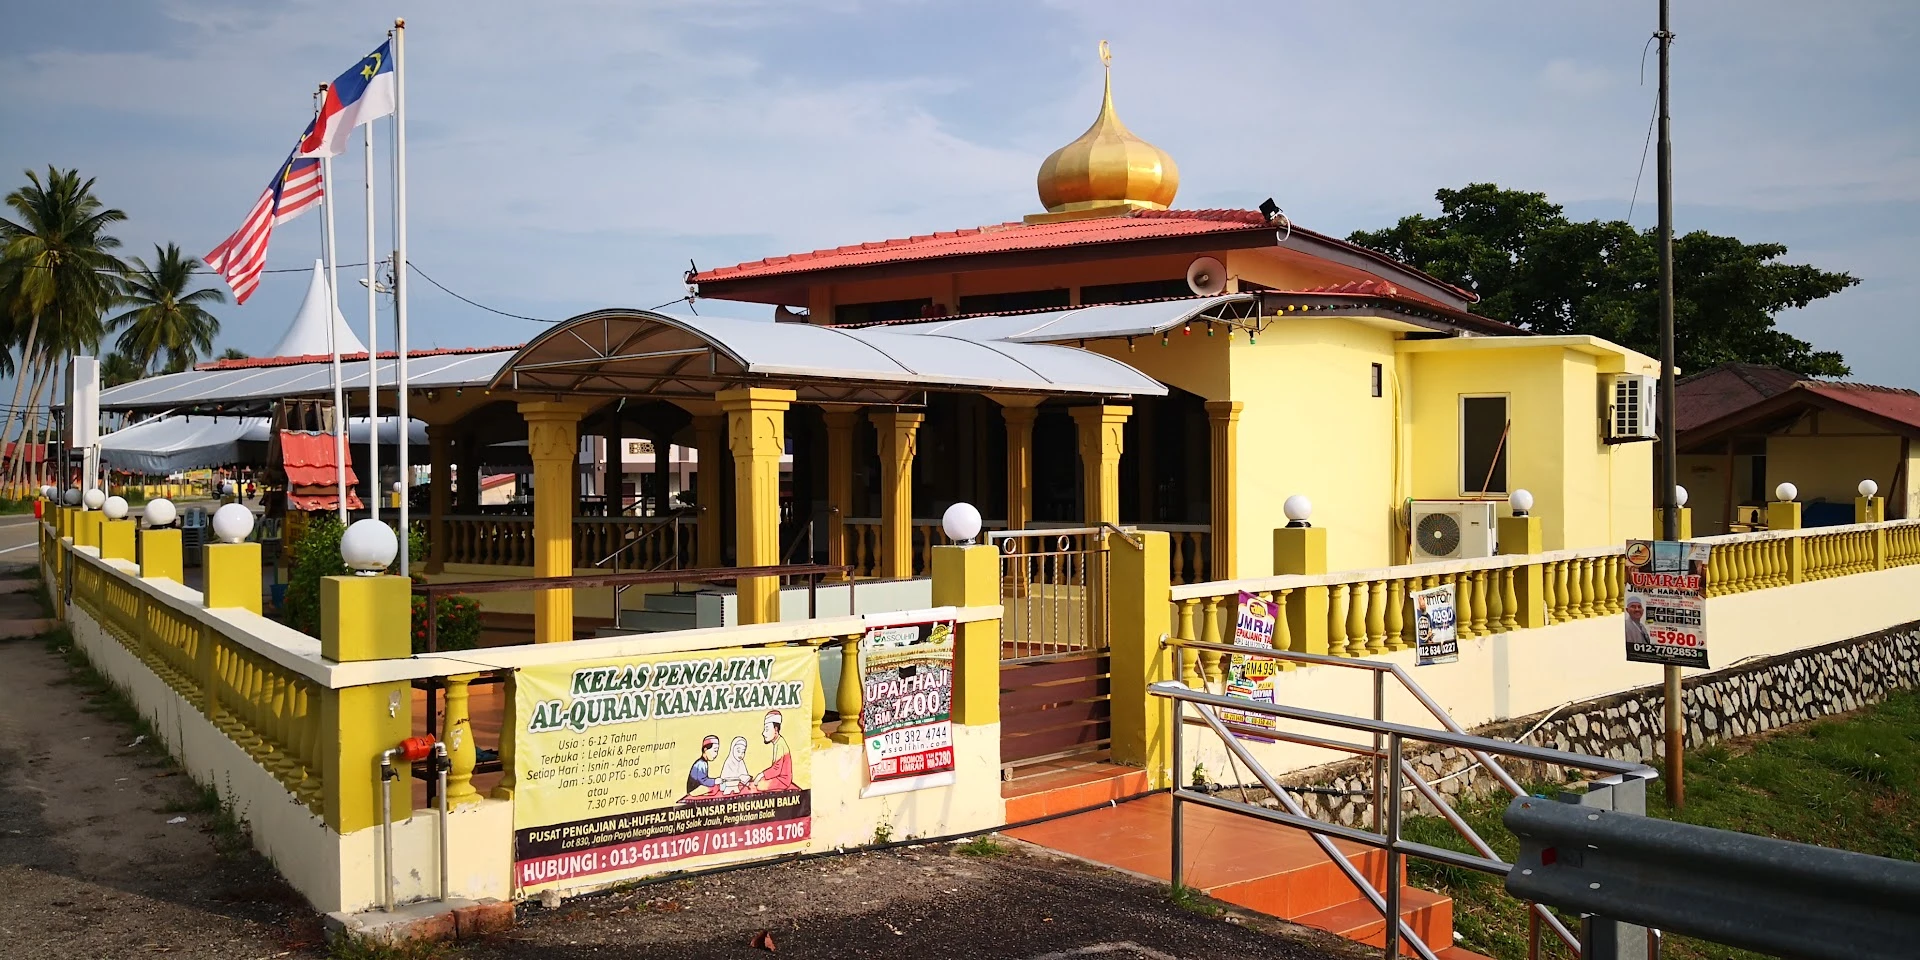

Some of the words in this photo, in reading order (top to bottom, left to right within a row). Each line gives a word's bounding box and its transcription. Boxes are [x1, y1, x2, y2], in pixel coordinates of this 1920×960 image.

[1632, 573, 1699, 589] UMRAH
[1657, 588, 1699, 597] HARAMAIN
[1430, 645, 1441, 656] 634
[1633, 643, 1698, 658] 012-7702853
[1657, 631, 1697, 647] 5980
[572, 666, 650, 695] KELAS
[651, 657, 774, 687] PENGAJIAN
[867, 676, 908, 701] UPAH
[912, 669, 948, 692] HAJI
[530, 693, 651, 731] AL-QURAN
[654, 683, 802, 717] KANAK-KANAK
[875, 709, 890, 726] RM
[892, 691, 941, 720] 1700
[558, 738, 579, 750] Usia
[588, 735, 608, 747] 6-12
[610, 732, 638, 745] Tahun
[904, 729, 921, 743] 382
[925, 726, 947, 741] 4744
[541, 752, 579, 765] Terbuka
[588, 746, 616, 760] Lelaki
[616, 745, 624, 755] &
[625, 740, 676, 755] Perempuan
[934, 750, 952, 767] 5280
[526, 768, 556, 781] Setiap
[558, 764, 579, 776] Hari
[587, 760, 610, 773] Isnin
[616, 756, 641, 768] Ahad
[558, 778, 579, 789] Jam
[587, 772, 607, 785] 5.00
[608, 770, 626, 782] PTG
[633, 766, 652, 779] 6.30
[653, 764, 671, 776] PTG
[587, 786, 609, 798] atau
[587, 798, 607, 811] 7.30
[631, 792, 650, 804] 9.00
[651, 788, 672, 800] MLM
[529, 831, 564, 843] PUSAT
[563, 821, 617, 838] PENGAJIAN
[618, 812, 667, 829] AL-HUFFAZ
[668, 809, 696, 822] DARUL
[696, 804, 726, 817] ANSAR
[727, 799, 775, 814] PENGKALAN
[776, 795, 801, 807] BALAK
[561, 839, 574, 849] Lot
[575, 837, 591, 848] 830,
[591, 833, 614, 845] Jalan
[632, 824, 676, 838] Mengkuang,
[676, 821, 685, 833] Kg
[702, 816, 722, 828] Jauh,
[723, 811, 759, 825] Pengkalan
[523, 852, 598, 882] HUBUNGI
[601, 855, 607, 868] :
[609, 835, 700, 867] 013-6111706
[702, 833, 709, 855] /
[711, 825, 774, 851] 011-1886
[775, 821, 805, 842] 1706
